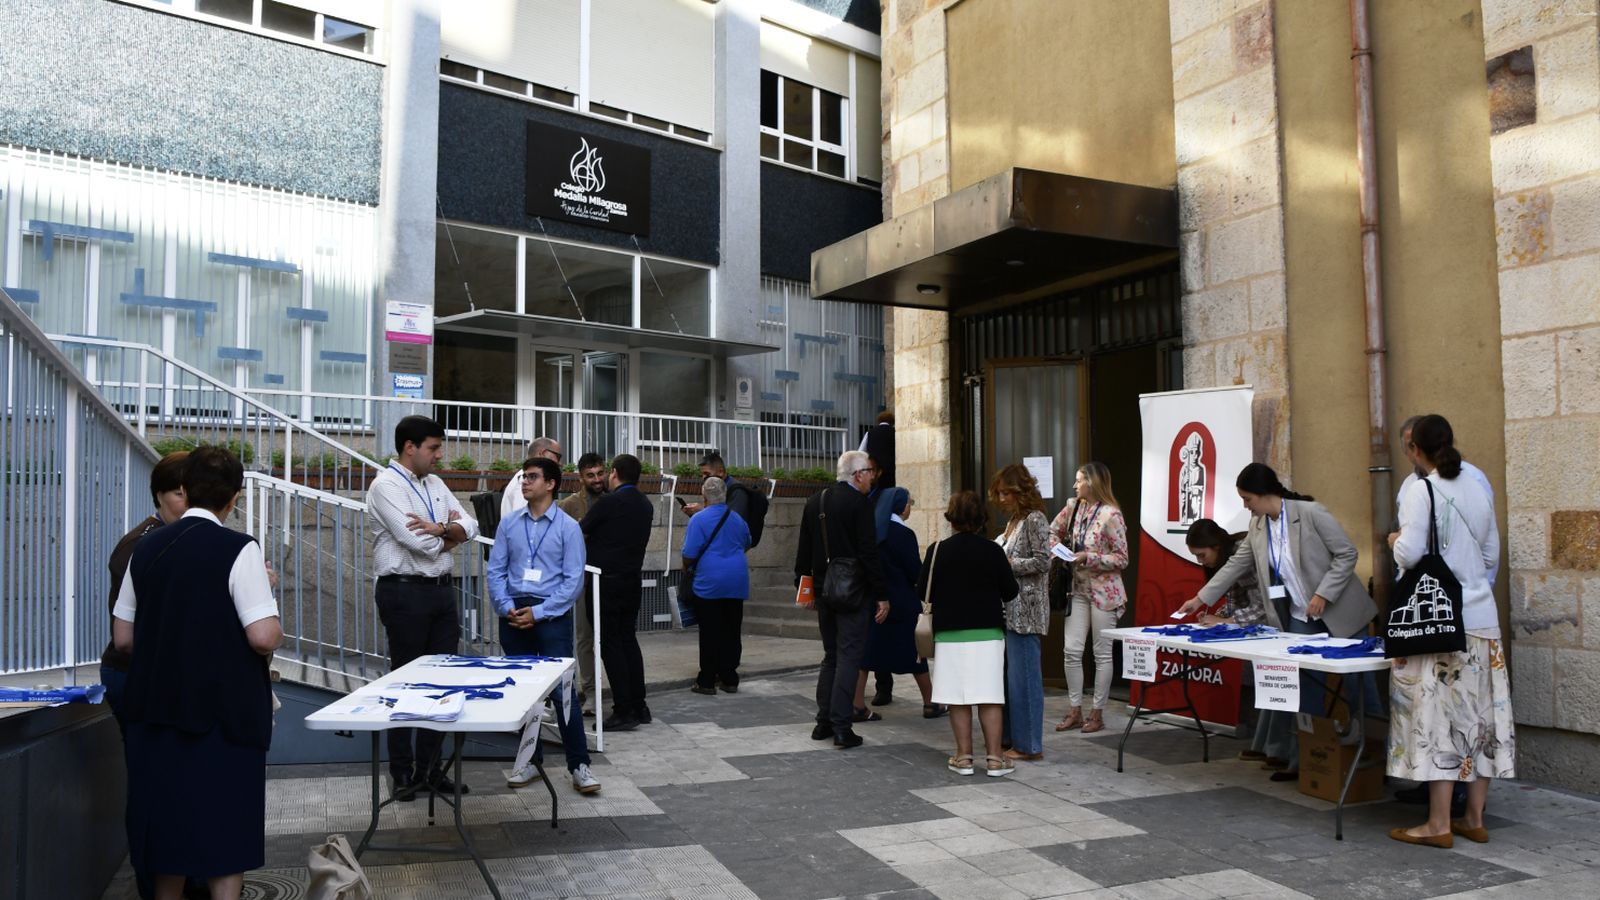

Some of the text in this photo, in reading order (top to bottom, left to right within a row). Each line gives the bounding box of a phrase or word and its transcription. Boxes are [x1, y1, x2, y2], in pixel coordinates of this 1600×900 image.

[560, 182, 585, 193] Colegio
[554, 188, 627, 210] Medalla Milagrosa
[1387, 623, 1456, 639] Colegiata de Toro
